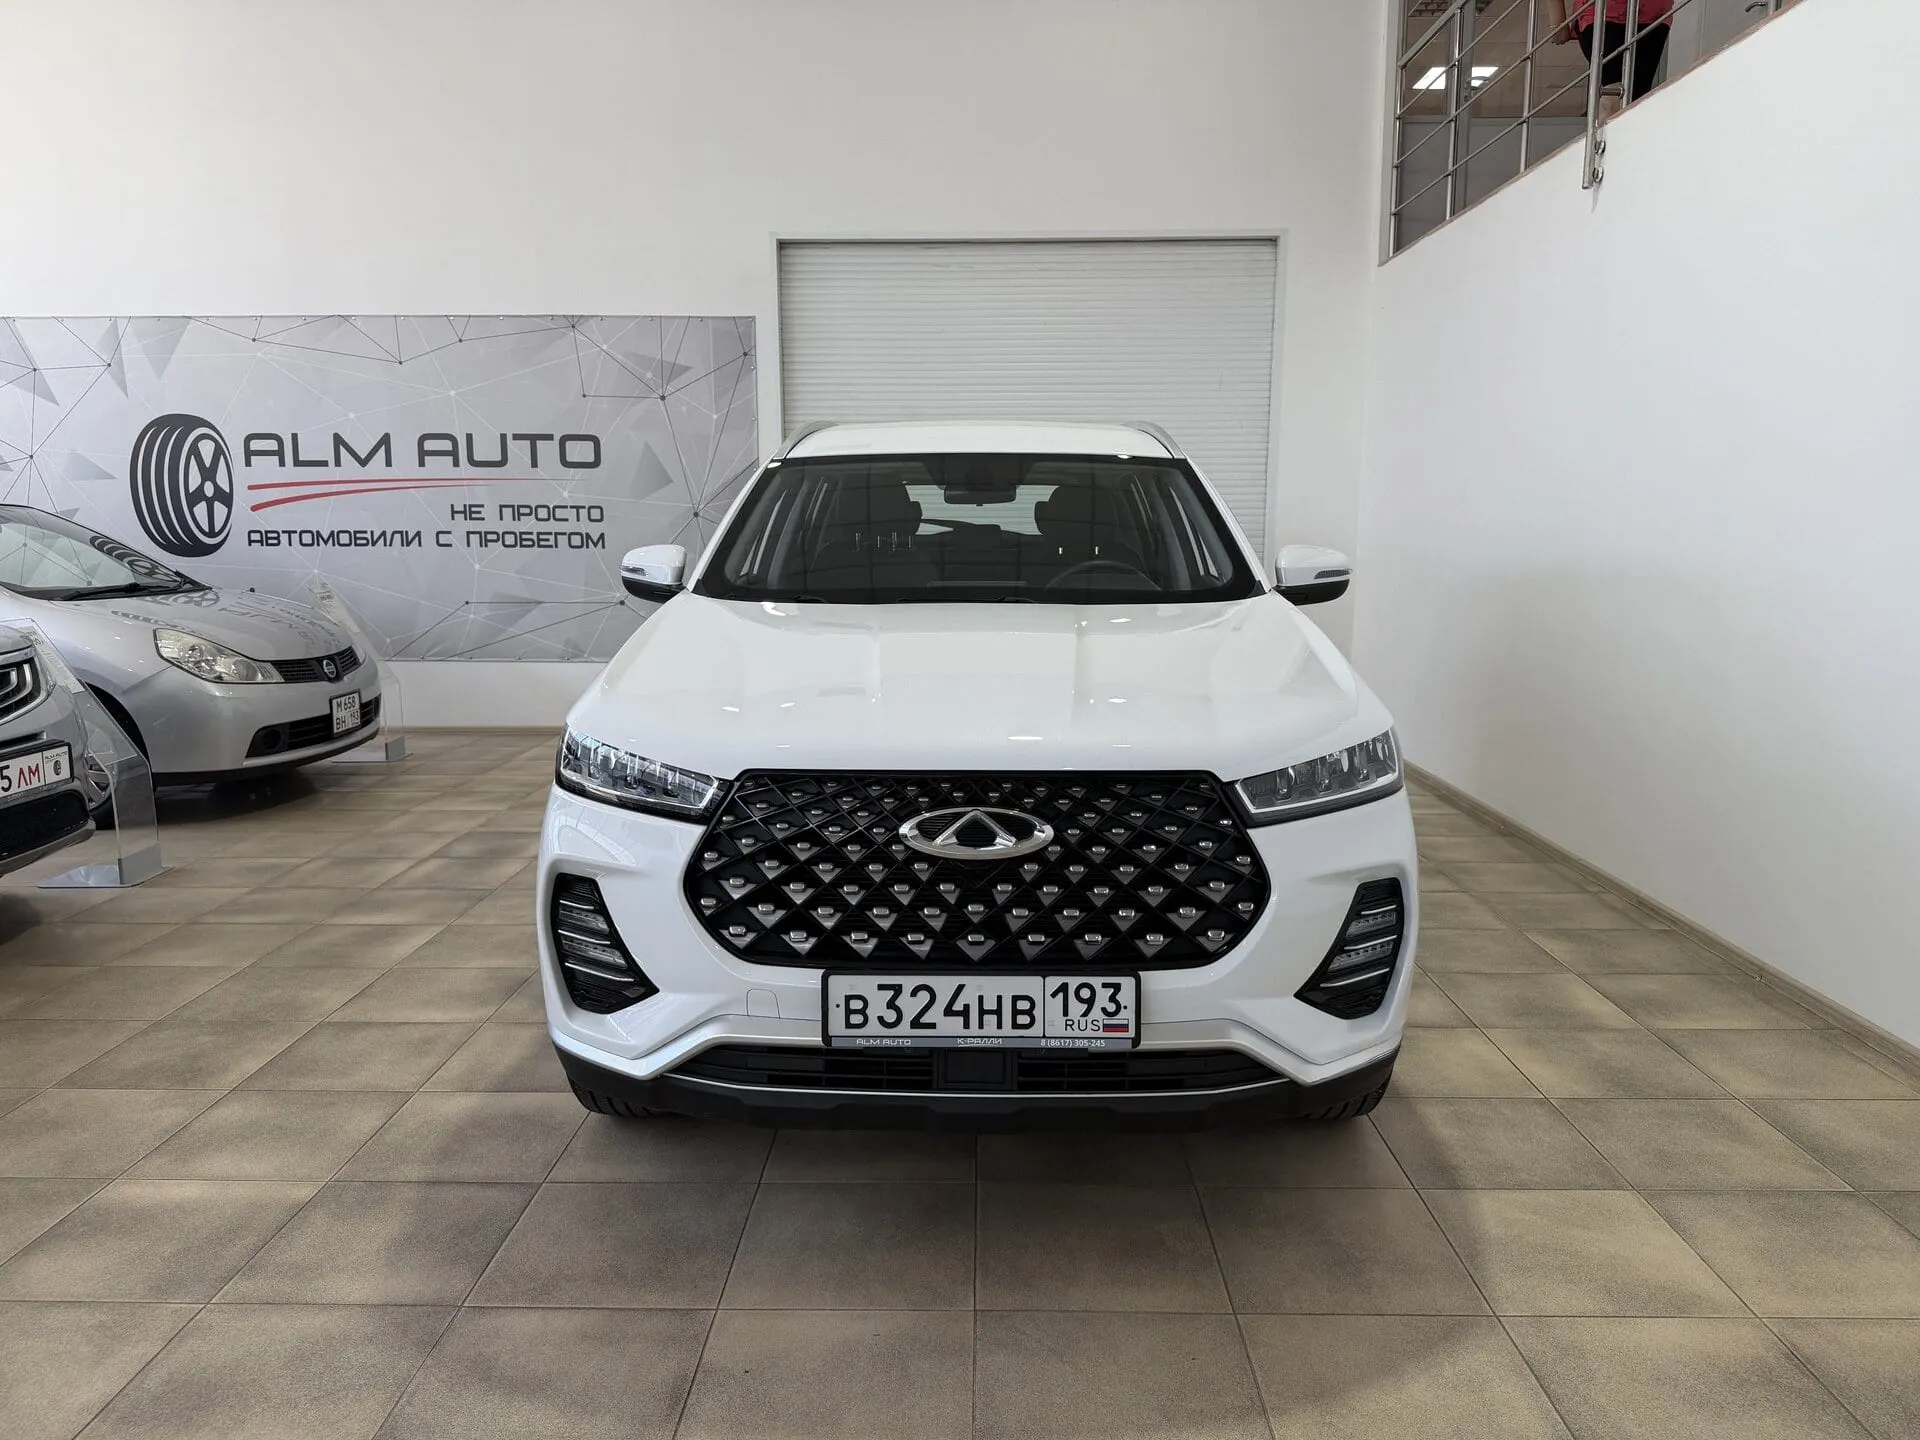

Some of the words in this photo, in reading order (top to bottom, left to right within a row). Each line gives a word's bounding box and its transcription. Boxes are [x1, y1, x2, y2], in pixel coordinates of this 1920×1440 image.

[243, 432, 392, 468] ALM
[417, 432, 602, 469] AUTO
[450, 503, 485, 521] НЕ
[499, 503, 605, 523] ПРОСТО
[247, 529, 422, 547] АВТОМОБИЛИ
[435, 530, 453, 548] С
[466, 530, 606, 549] ПРОБЕГОМ
[1050, 982, 1122, 1018] 193
[1064, 1019, 1100, 1031] RUS
[1047, 1038, 1073, 1047] (8617)
[1074, 1039, 1105, 1047] 305-245
